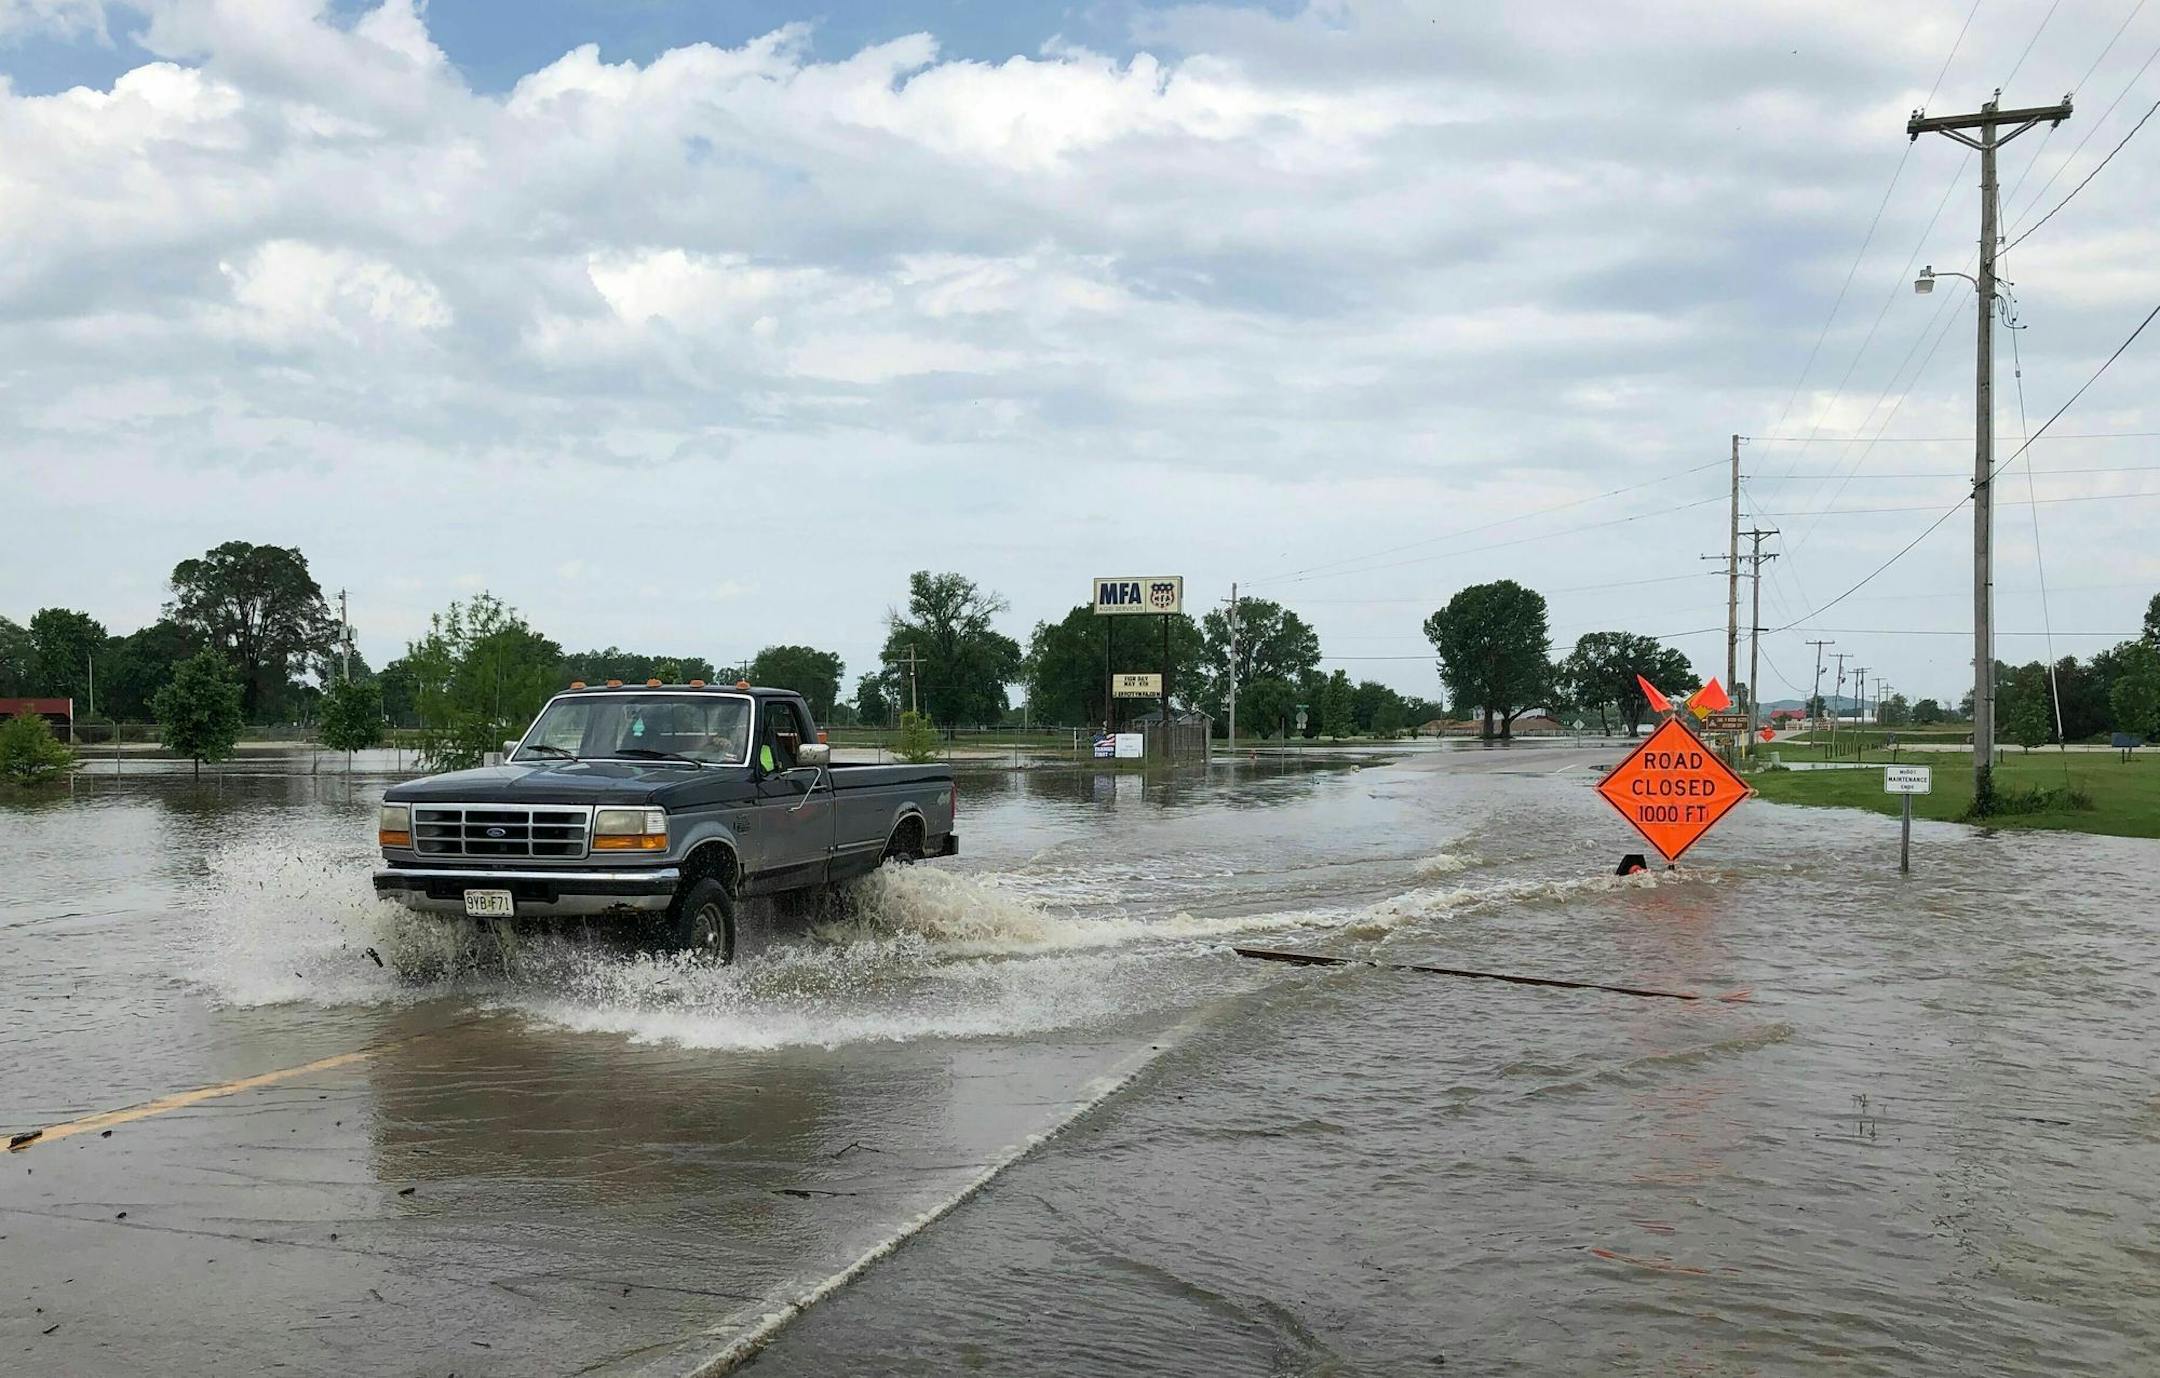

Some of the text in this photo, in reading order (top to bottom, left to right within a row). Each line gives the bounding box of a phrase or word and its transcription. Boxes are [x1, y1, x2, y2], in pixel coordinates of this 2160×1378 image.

[1099, 582, 1142, 605] MFA
[1644, 752, 1703, 769] ROAD
[1632, 779, 1715, 796] CLOSED
[1639, 805, 1706, 822] 1000 FT
